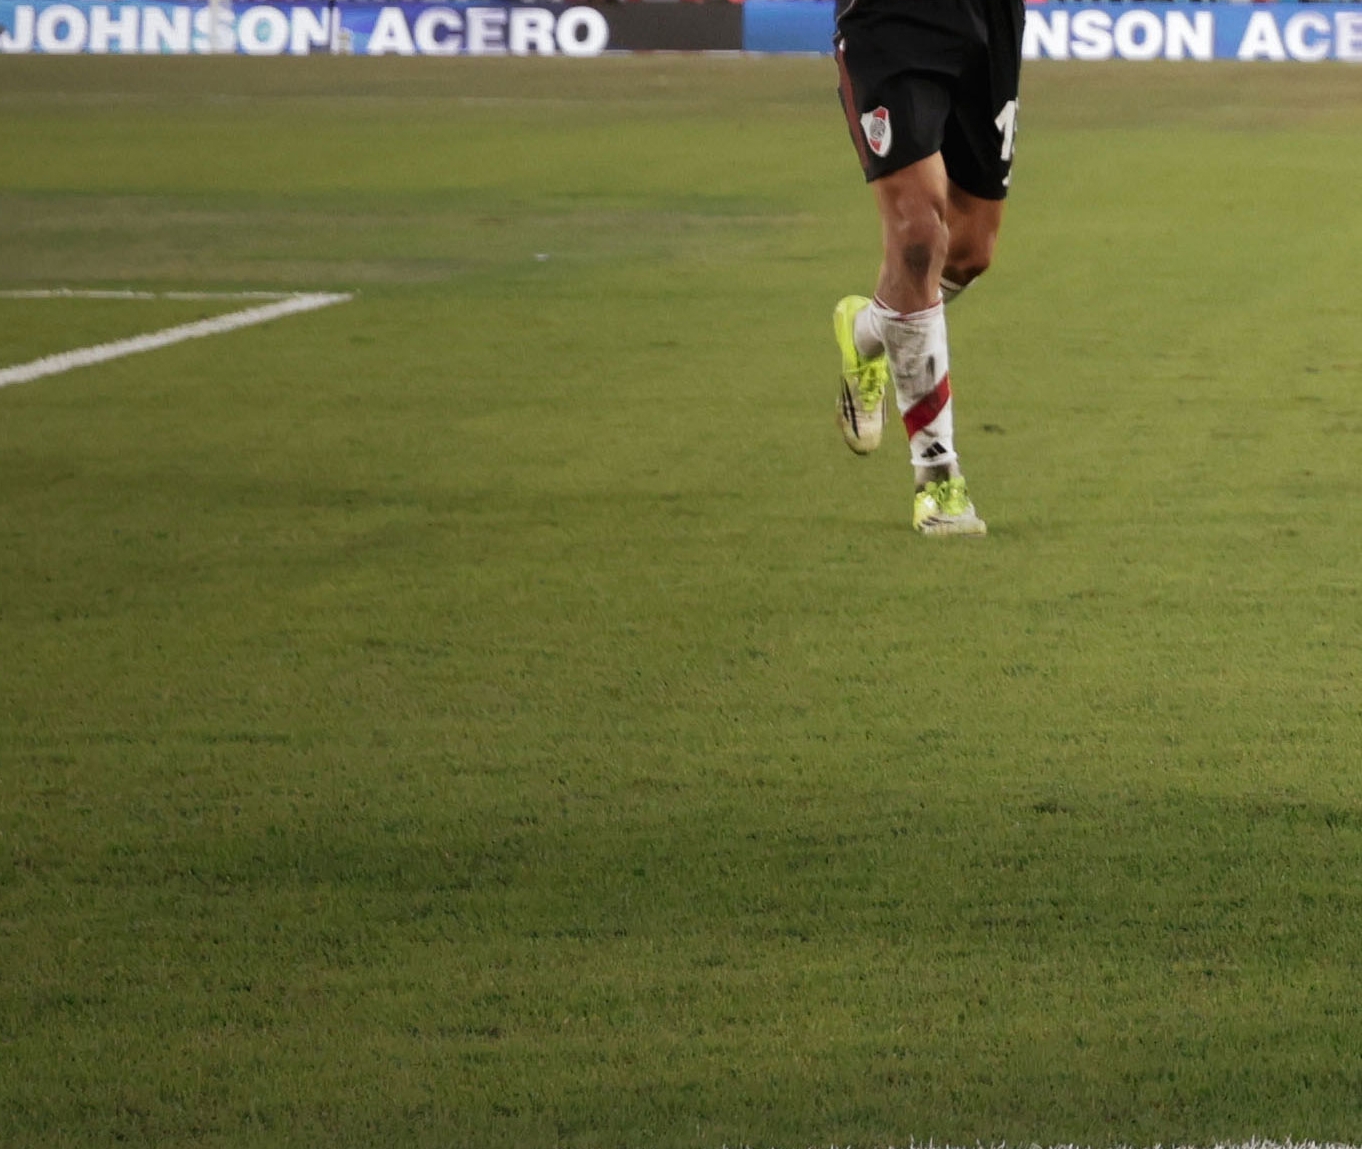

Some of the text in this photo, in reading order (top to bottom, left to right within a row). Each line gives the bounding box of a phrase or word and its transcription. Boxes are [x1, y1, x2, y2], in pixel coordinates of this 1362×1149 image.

[2, 5, 610, 56] JOHNSON ACERO
[1025, 10, 1214, 60] NSON
